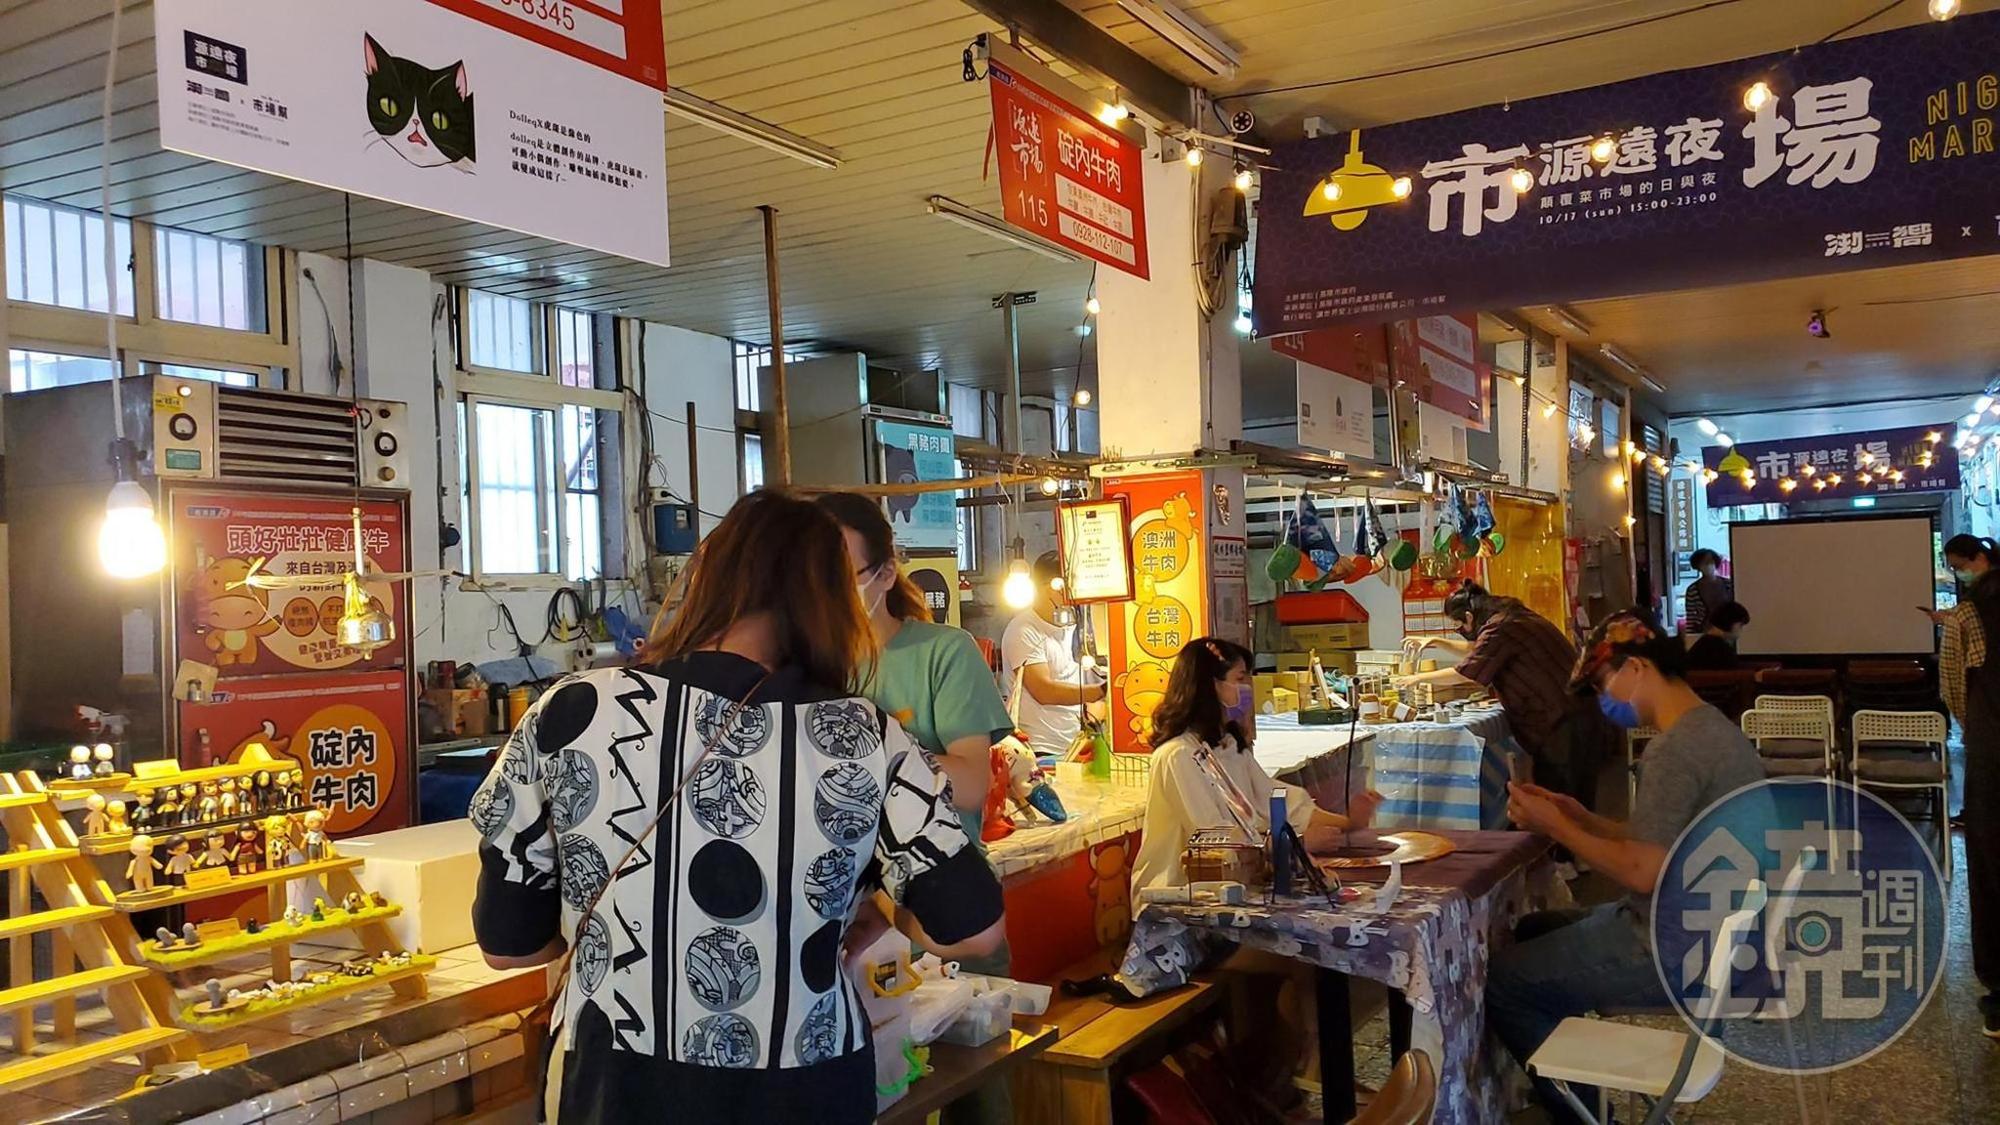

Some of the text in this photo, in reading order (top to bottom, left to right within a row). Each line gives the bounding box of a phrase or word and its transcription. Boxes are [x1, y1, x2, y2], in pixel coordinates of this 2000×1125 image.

[1926, 74, 1998, 126] NIG
[1421, 76, 1882, 237] 市 源遠夜 場
[1908, 118, 1994, 164] MAR
[1057, 128, 1122, 194] 碇內牛肉
[1018, 190, 1048, 228] 115
[1539, 211, 1576, 225] 10/17
[1630, 192, 1718, 213] 15:00-23:00
[1540, 172, 1717, 210] 顛覆菜市場的日與夜
[1756, 451, 1791, 480] 市
[1143, 531, 1176, 550] 澳洲
[1143, 553, 1176, 572] 牛肉
[1146, 607, 1180, 626] 台灣
[1146, 629, 1180, 648] 牛肉
[309, 727, 376, 768] 碇內
[311, 771, 377, 812] 牛肉
